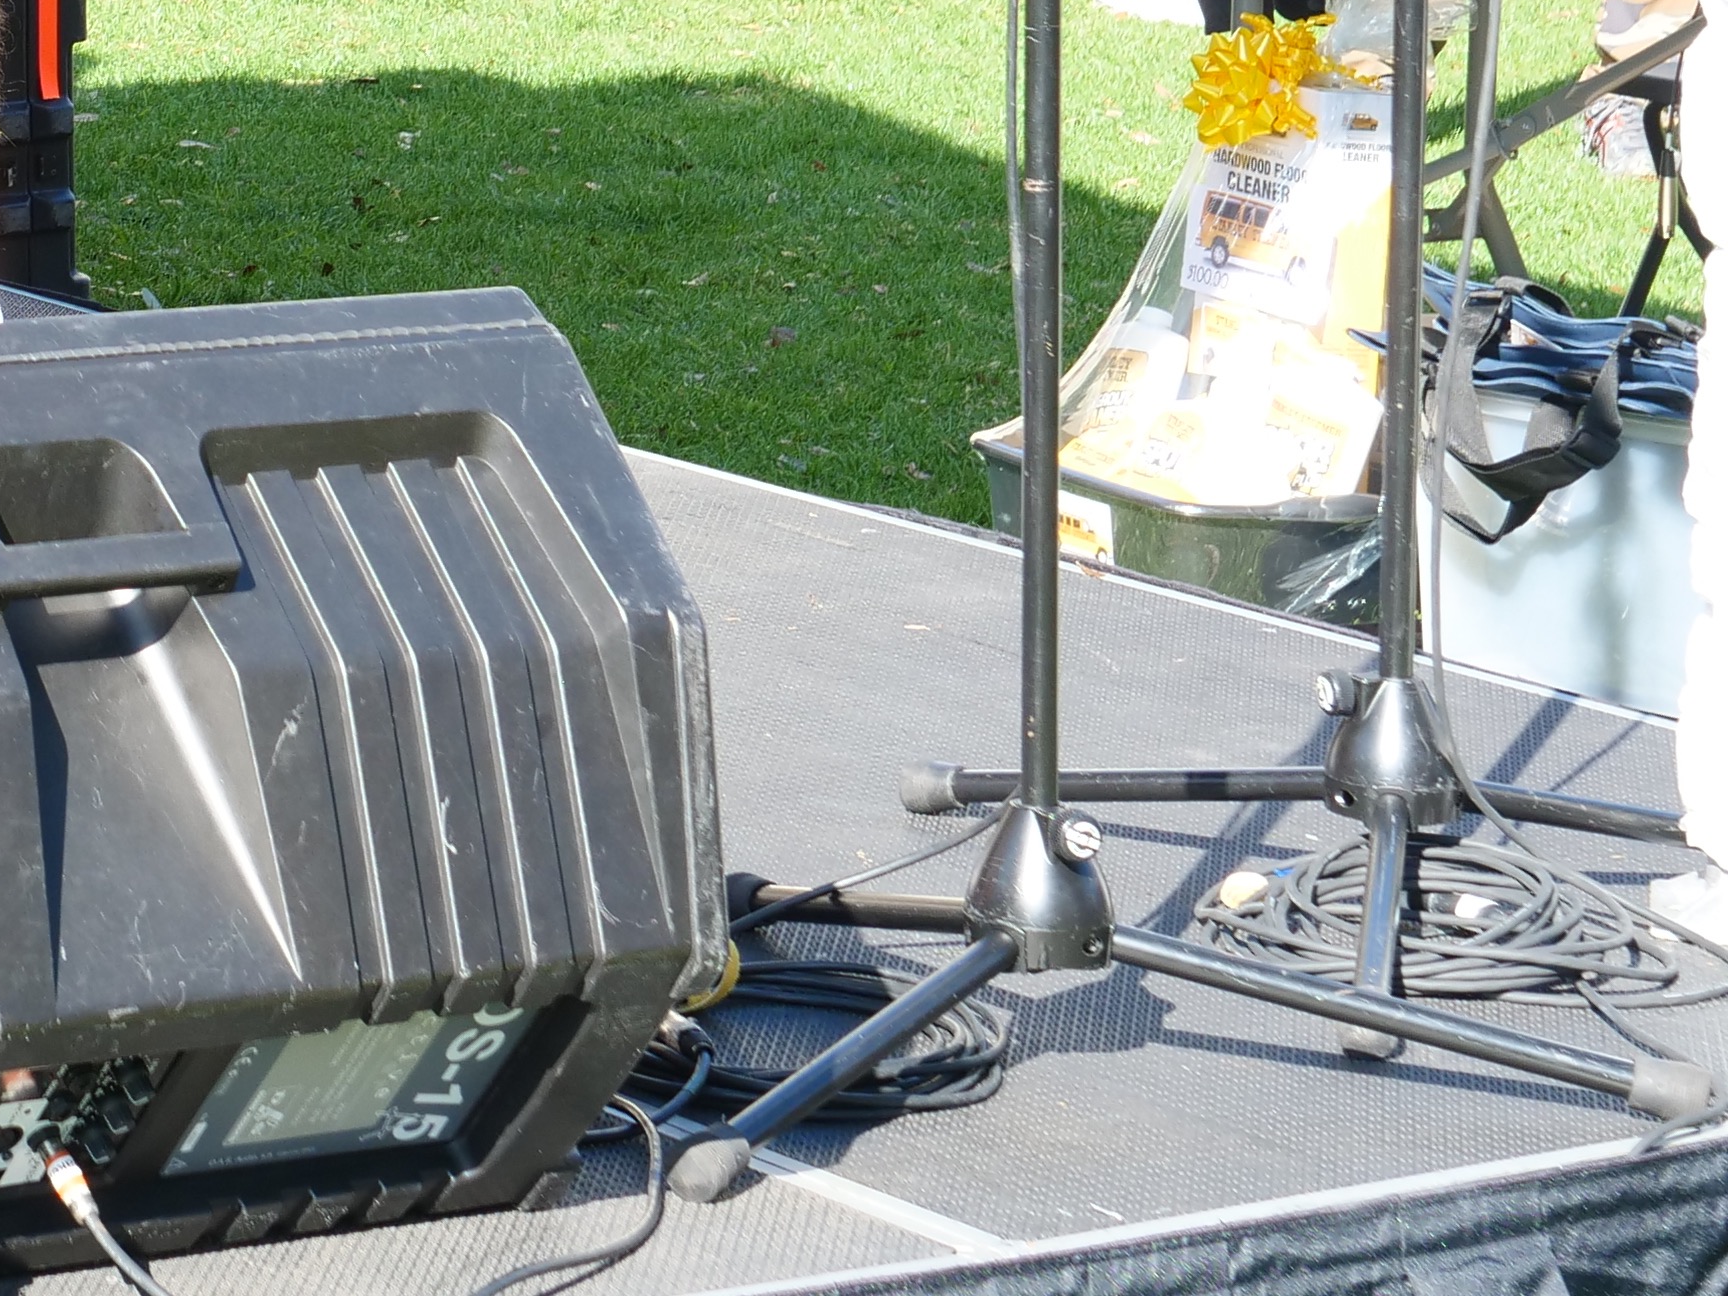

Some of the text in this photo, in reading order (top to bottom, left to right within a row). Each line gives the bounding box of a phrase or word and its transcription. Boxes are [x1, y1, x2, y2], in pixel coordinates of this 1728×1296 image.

[1213, 148, 1271, 176] HARDWOOD
[1342, 153, 1380, 163] LEANER
[1227, 170, 1291, 204] CLEANER
